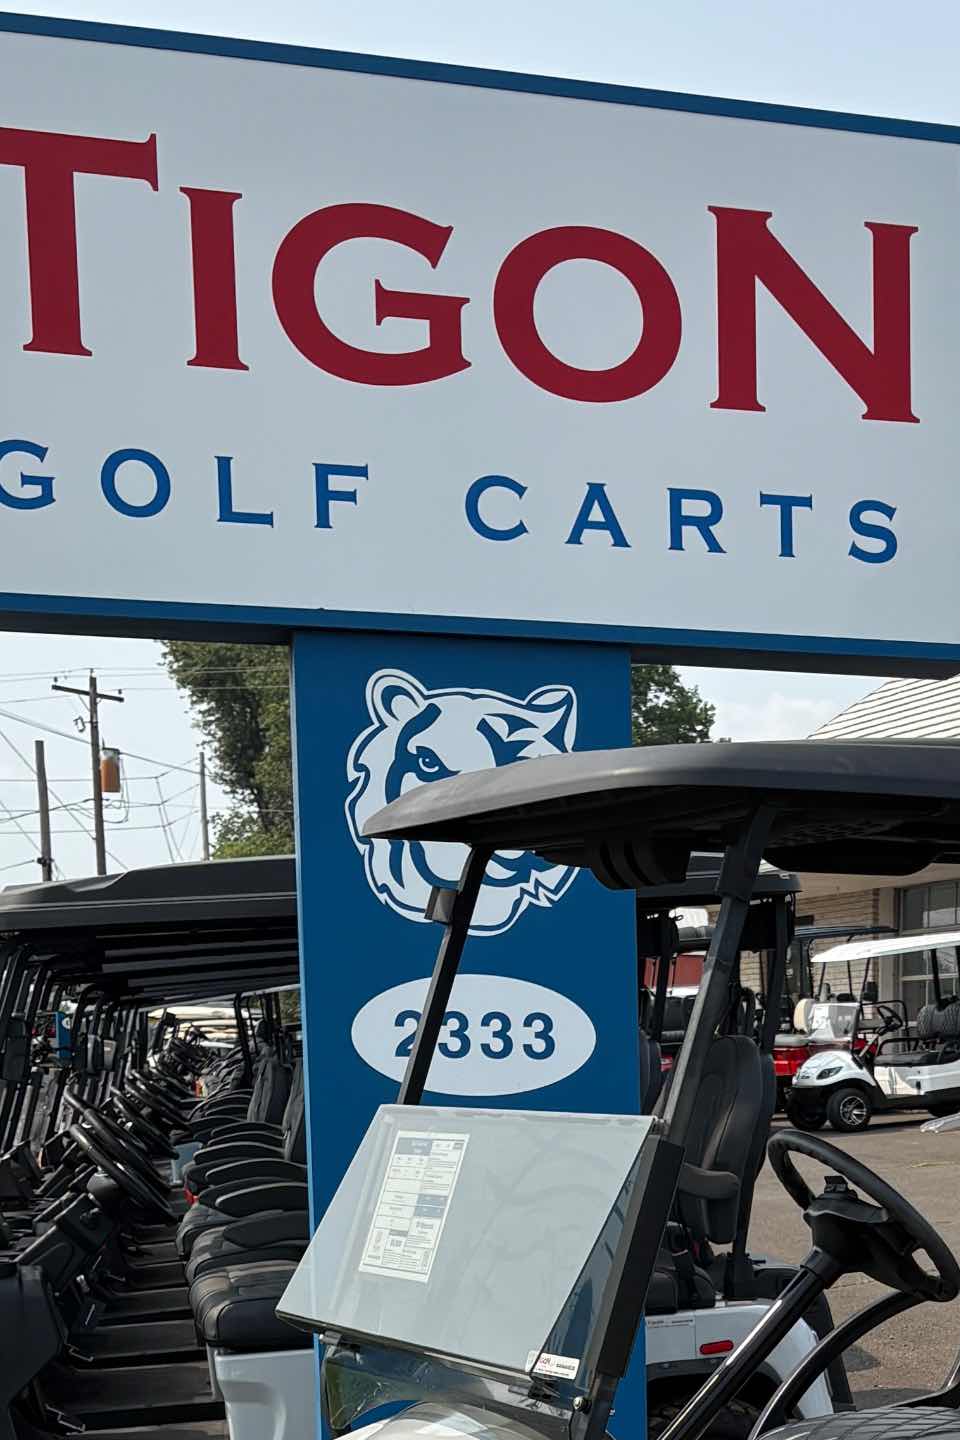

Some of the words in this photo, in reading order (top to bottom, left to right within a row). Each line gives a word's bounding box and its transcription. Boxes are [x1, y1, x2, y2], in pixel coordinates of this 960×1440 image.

[0, 127, 919, 424] TIGON
[0, 439, 369, 529] GOLF
[465, 474, 898, 564] CARTS
[394, 1010, 556, 1060] 2333
